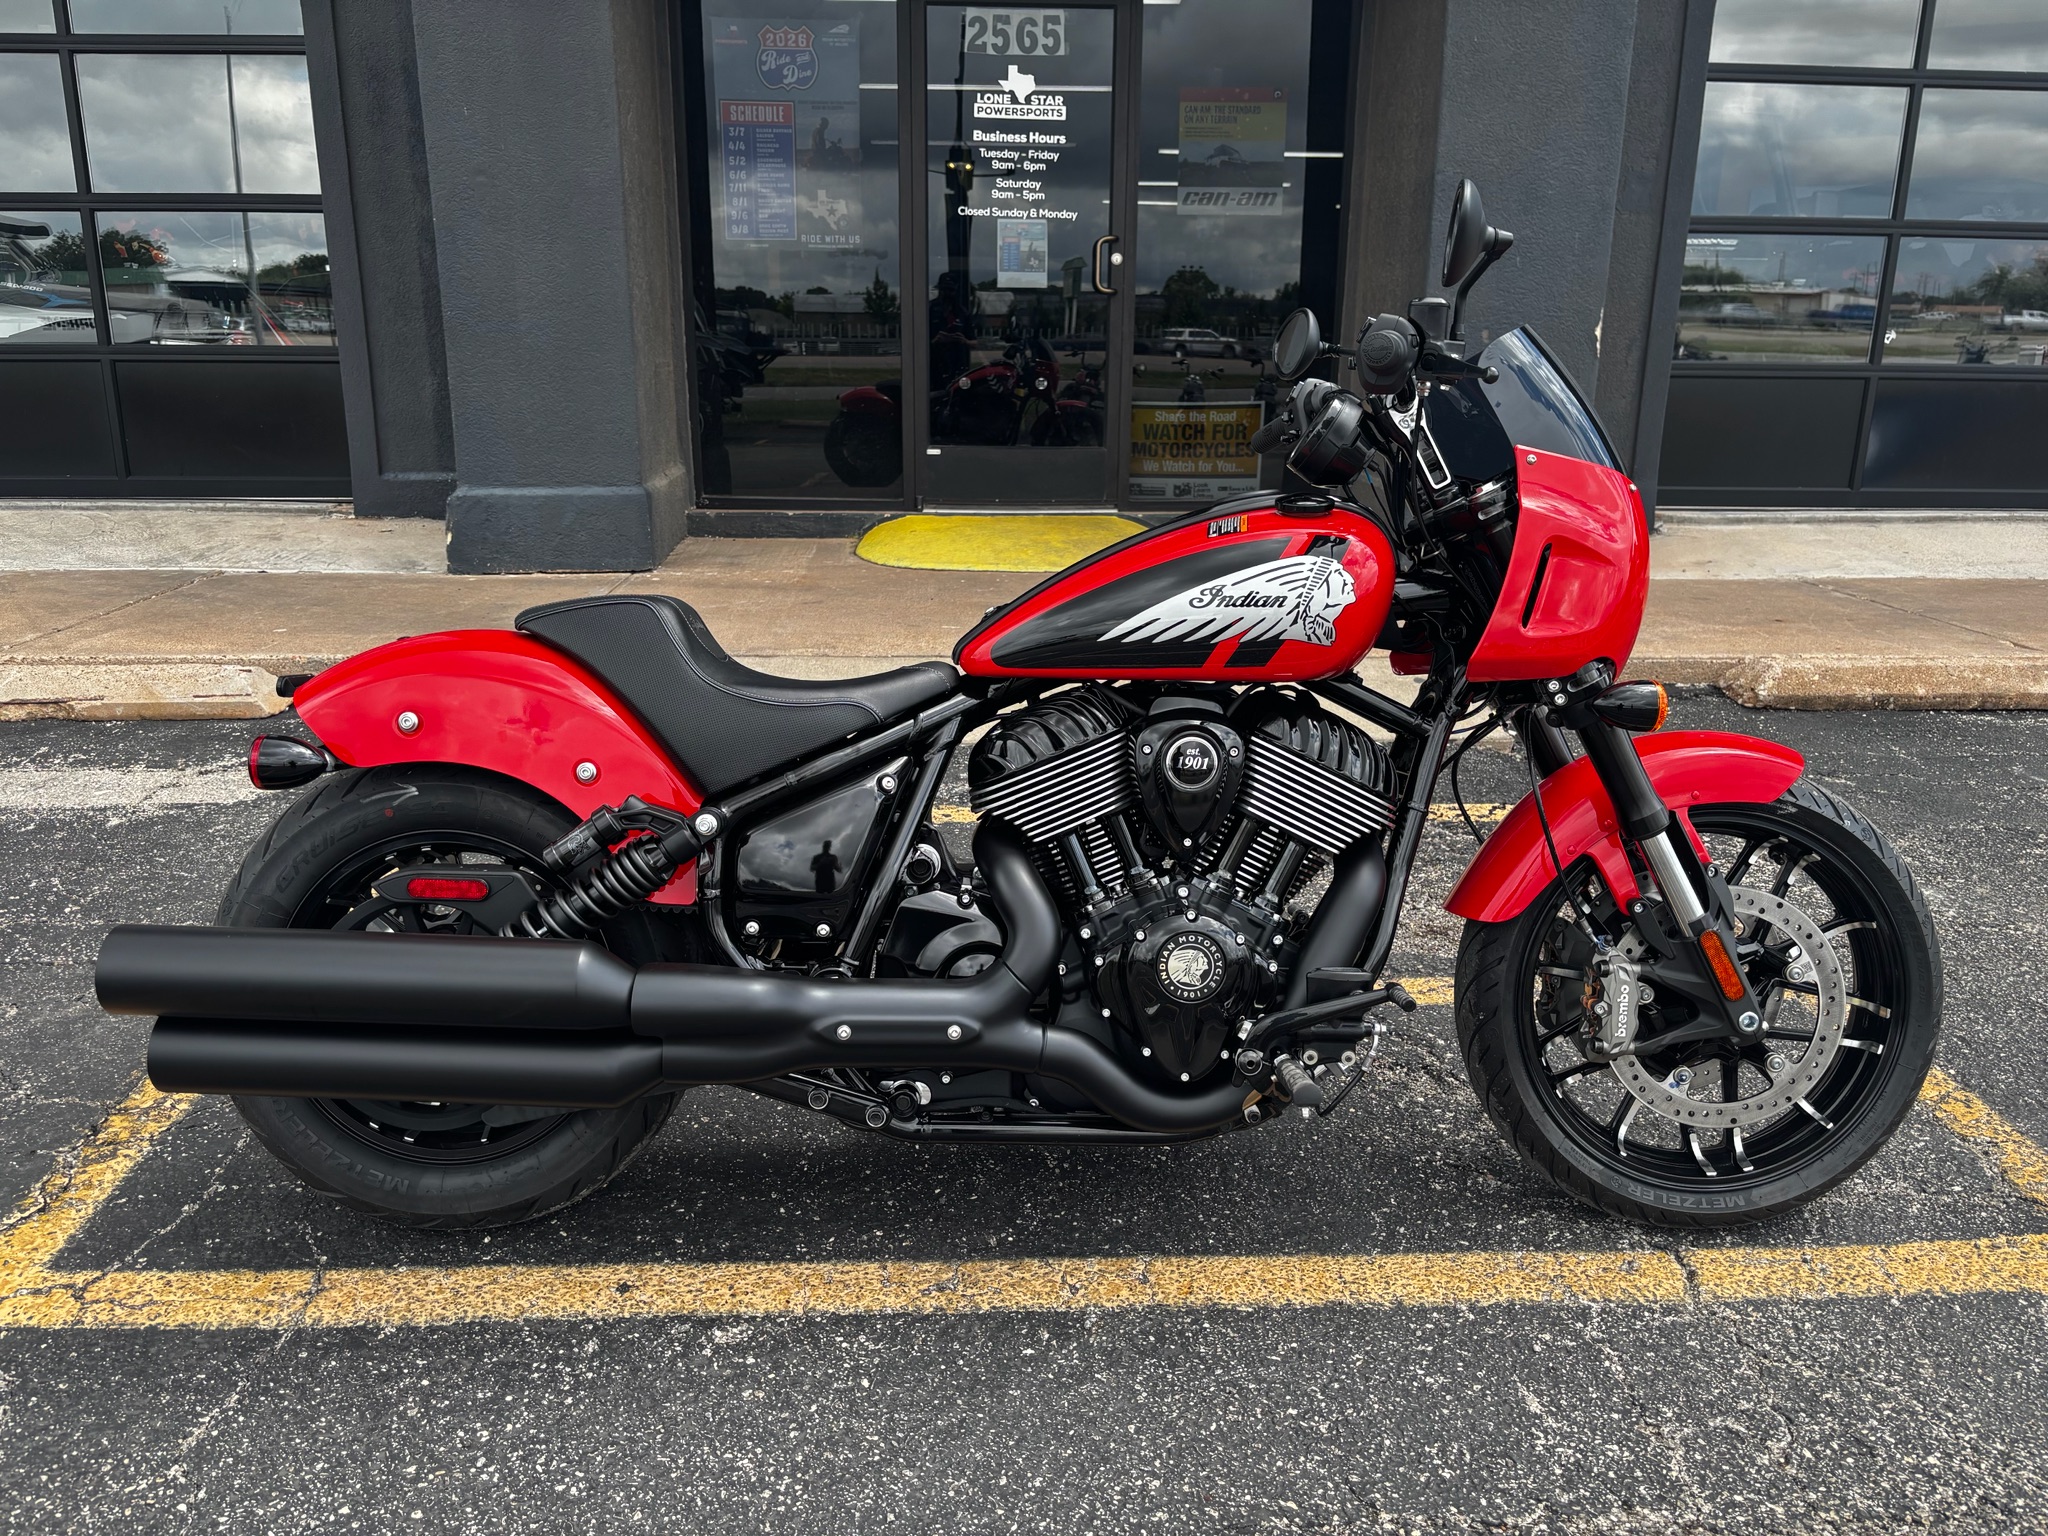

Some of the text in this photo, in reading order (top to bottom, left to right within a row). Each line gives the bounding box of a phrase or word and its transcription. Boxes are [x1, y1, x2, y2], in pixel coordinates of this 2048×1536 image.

[765, 32, 807, 47] 2026
[966, 14, 1062, 55] 2565
[761, 50, 791, 71] Ride
[782, 65, 812, 84] Dine
[976, 92, 1064, 106] LONE STAR
[729, 104, 785, 123] SCHEDULE
[976, 106, 1064, 118] POWERSPORTS
[1228, 105, 1262, 115] STANDARD
[1184, 115, 1238, 124] ON ANY TERRAIN
[728, 127, 745, 137] 3/7
[973, 129, 1067, 144] Business Hours
[728, 140, 746, 151] 4/4
[728, 156, 747, 166] 5/2
[979, 148, 1020, 161] Tuesday
[1028, 150, 1060, 162] Friday
[991, 160, 1015, 170] 9am
[1023, 161, 1046, 172] 6pm
[729, 170, 747, 180] 6/6
[728, 183, 747, 193] 7/11
[996, 178, 1042, 191] Saturday
[732, 197, 748, 207] 8/1
[991, 190, 1015, 199] 9am
[1022, 190, 1046, 202] 5pm
[1181, 191, 1278, 207] can-am
[731, 210, 748, 220] 9/6
[957, 206, 1078, 221] Closed Sunday & Monday
[731, 224, 749, 235] 9/8
[801, 234, 861, 244] RIDE WITH US
[1155, 411, 1237, 423] Share the Road
[1143, 423, 1247, 441] WATCH FOR
[1132, 442, 1255, 459] MOTORCYCLES
[1143, 460, 1159, 472] We
[1162, 459, 1195, 472] Watch
[1198, 459, 1213, 472] for
[1188, 584, 1289, 609] Indian
[1186, 747, 1201, 756] est.
[1176, 756, 1210, 770] 1901
[1159, 935, 1223, 988] INDIAN MOTORCYCLE
[1177, 989, 1201, 998] 1901
[1615, 984, 1630, 1037] brembo
[272, 1098, 410, 1196] METZELER
[1627, 1181, 1748, 1209] METZELER
